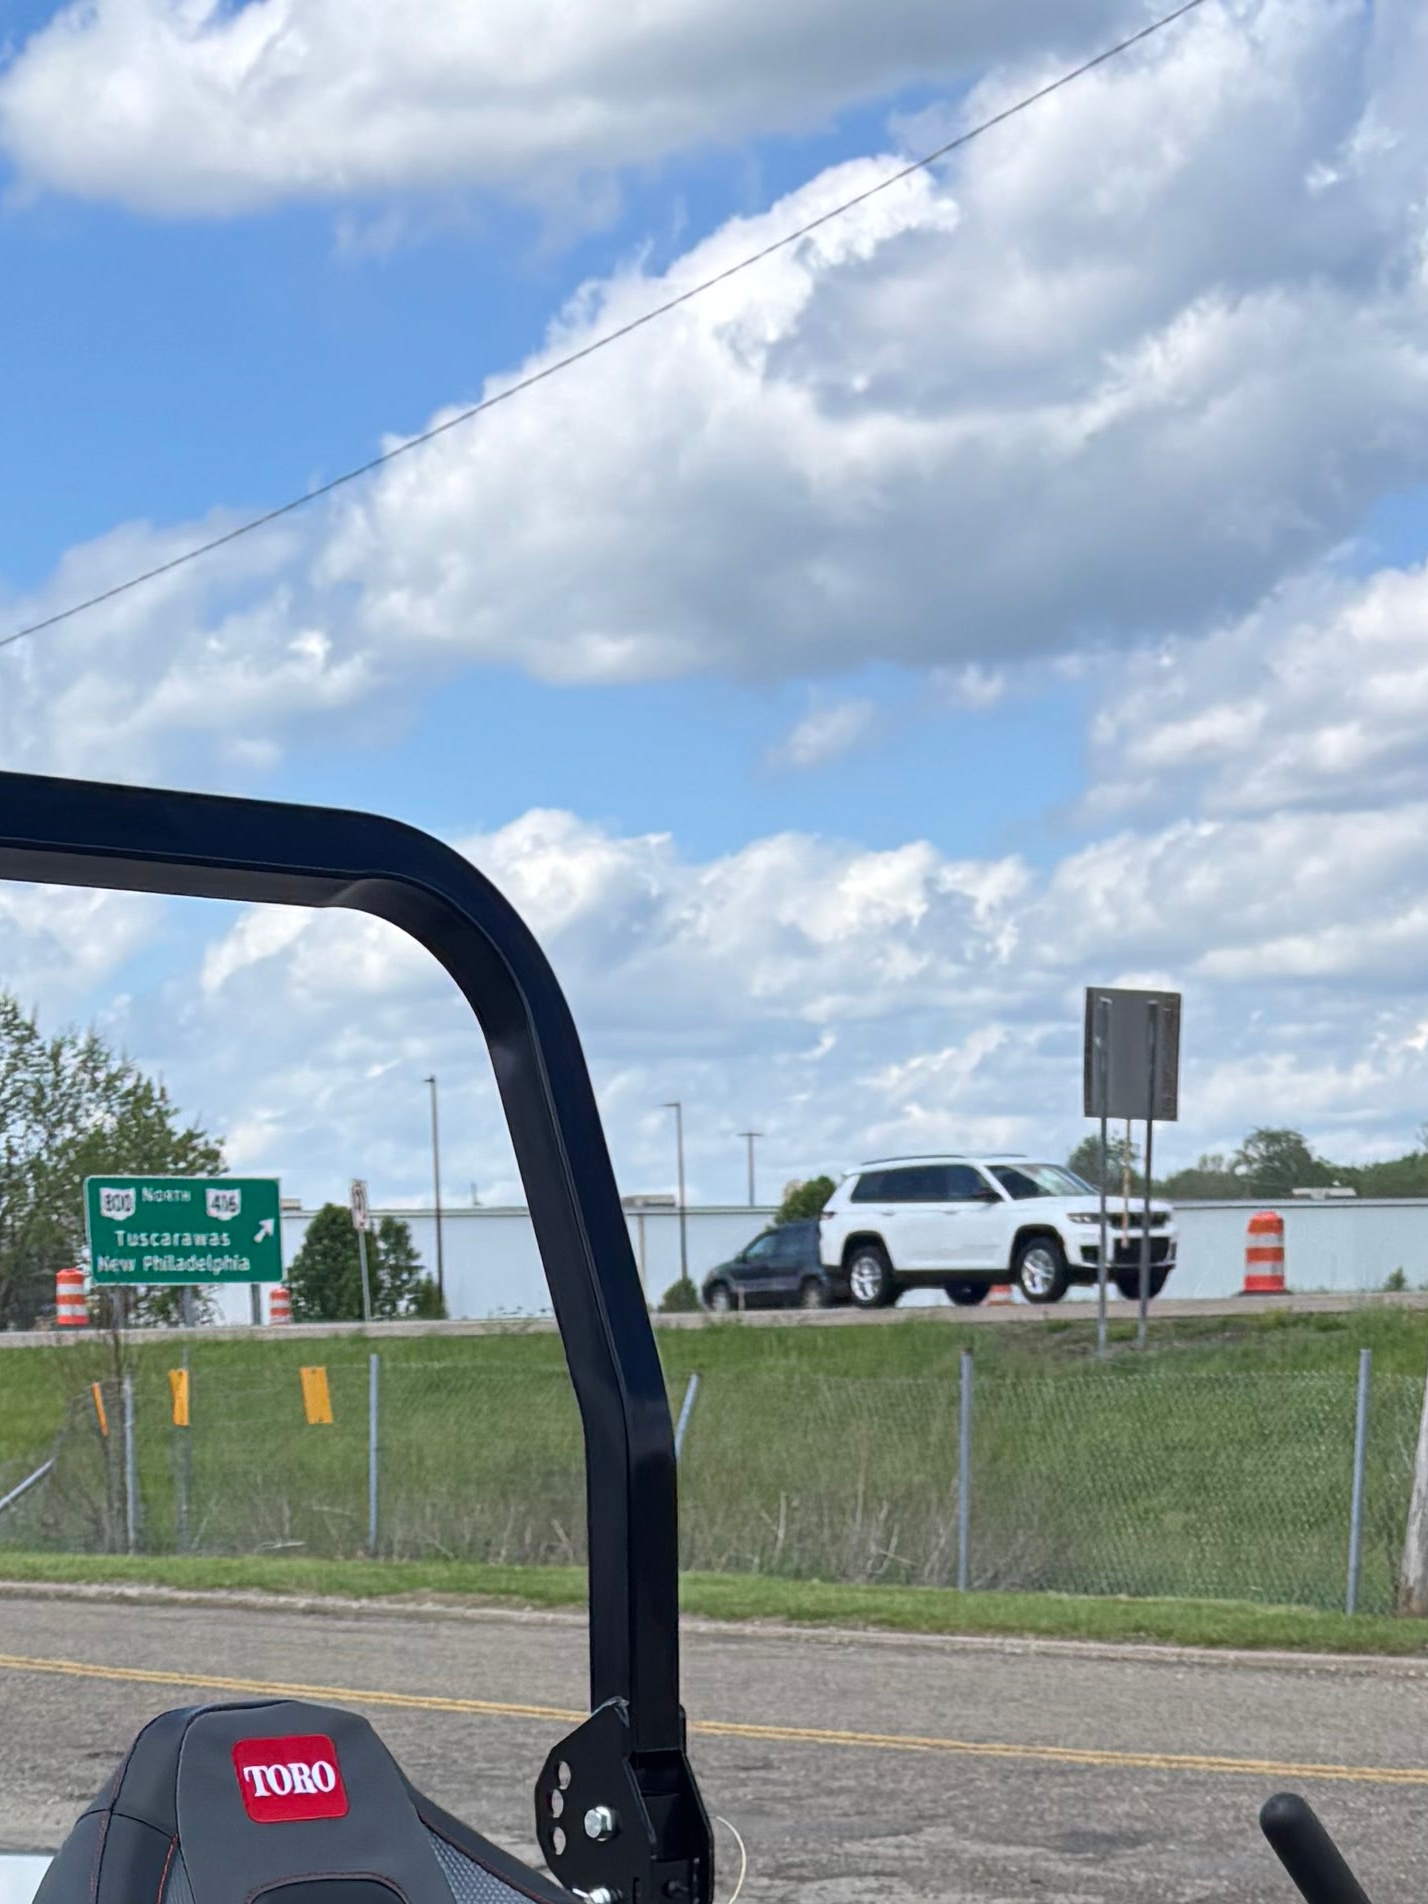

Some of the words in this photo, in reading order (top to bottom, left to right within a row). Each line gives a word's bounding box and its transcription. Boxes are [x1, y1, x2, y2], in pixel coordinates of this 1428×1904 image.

[115, 1230, 231, 1247] Tuscarawas
[97, 1256, 136, 1273] New
[142, 1254, 251, 1276] Philadelphia
[243, 1760, 336, 1797] TORO
